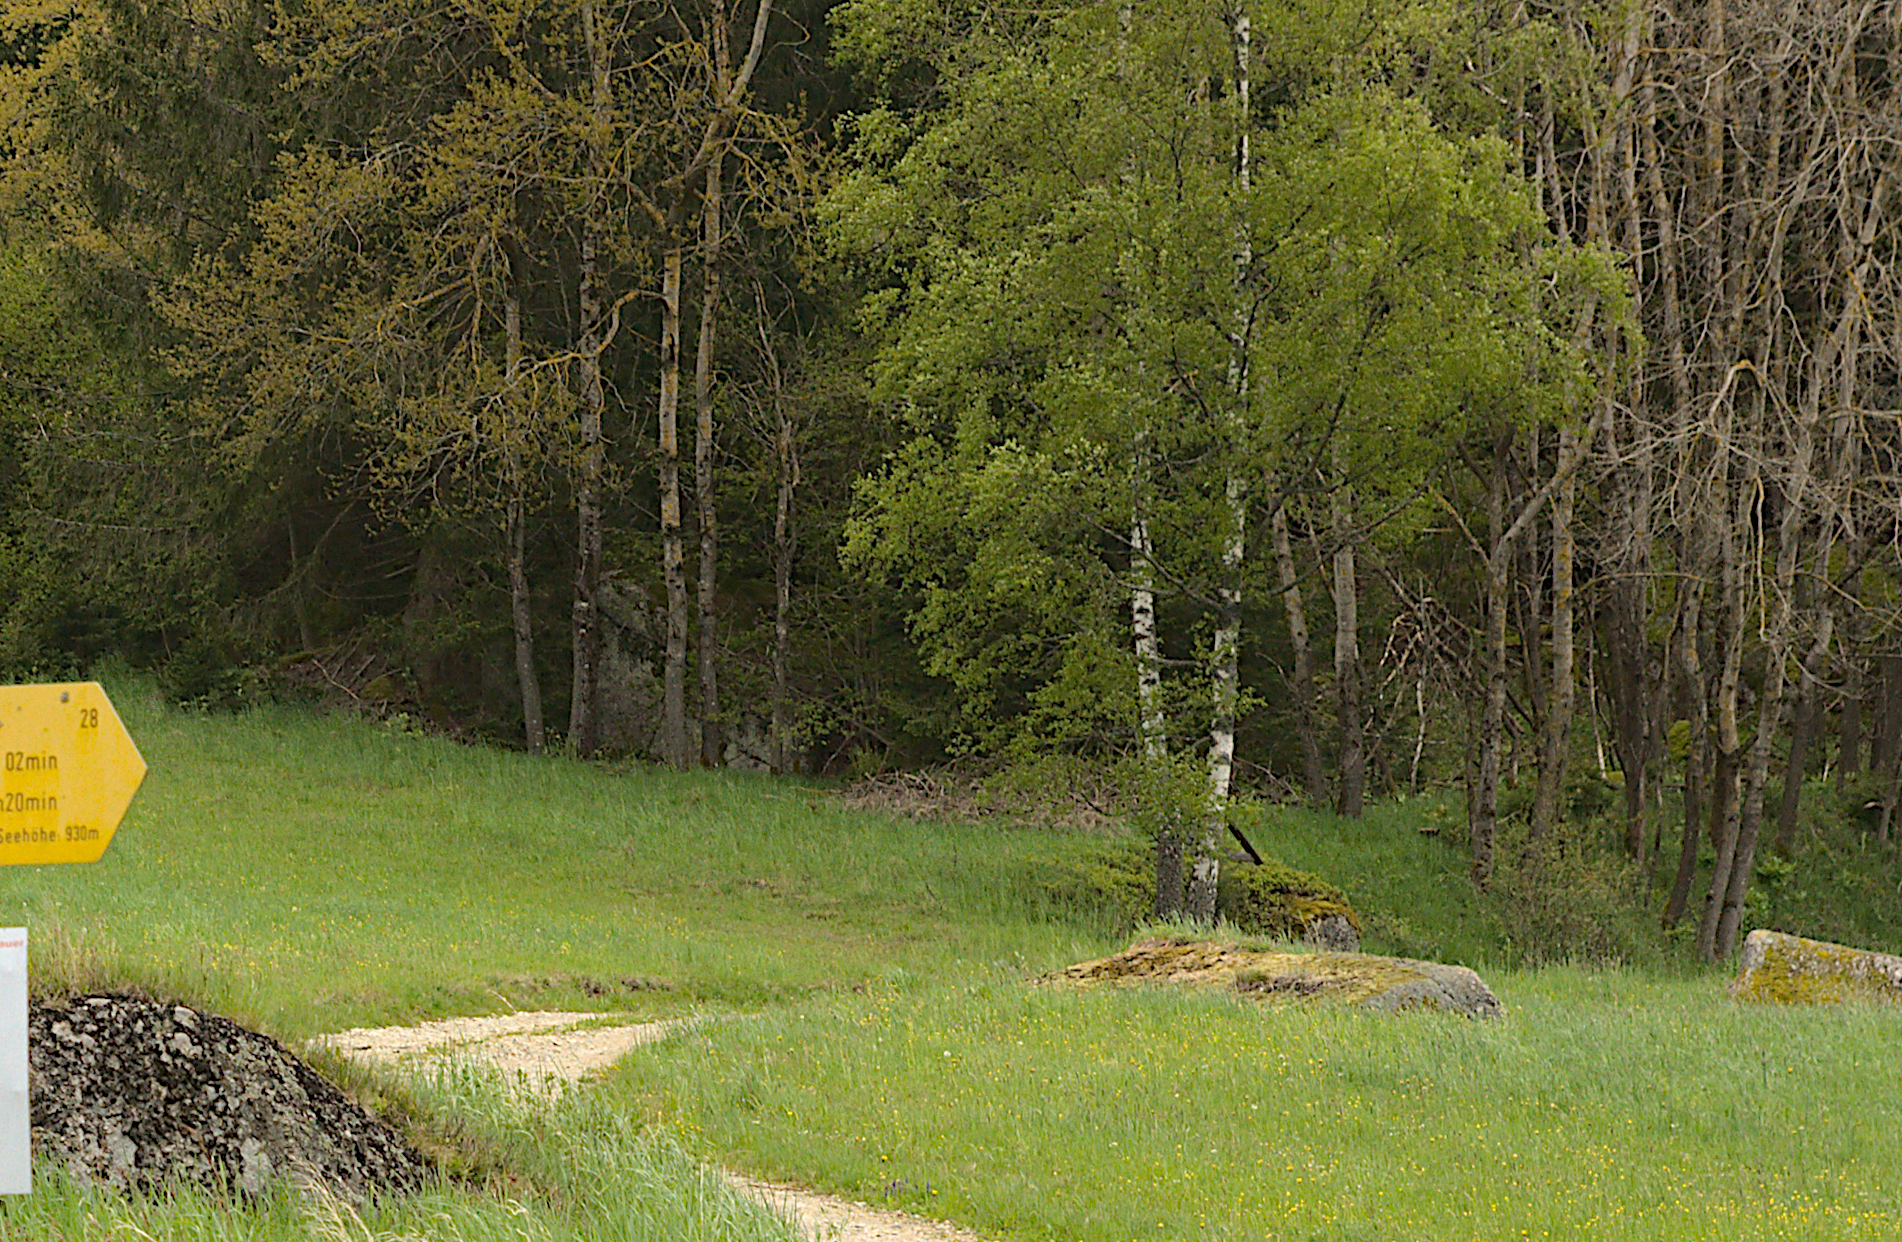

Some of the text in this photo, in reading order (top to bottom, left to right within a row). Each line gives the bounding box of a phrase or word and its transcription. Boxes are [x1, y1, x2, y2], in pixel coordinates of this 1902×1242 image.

[79, 708, 99, 729] 28
[5, 751, 58, 772] 02min
[65, 825, 99, 841] 930m
